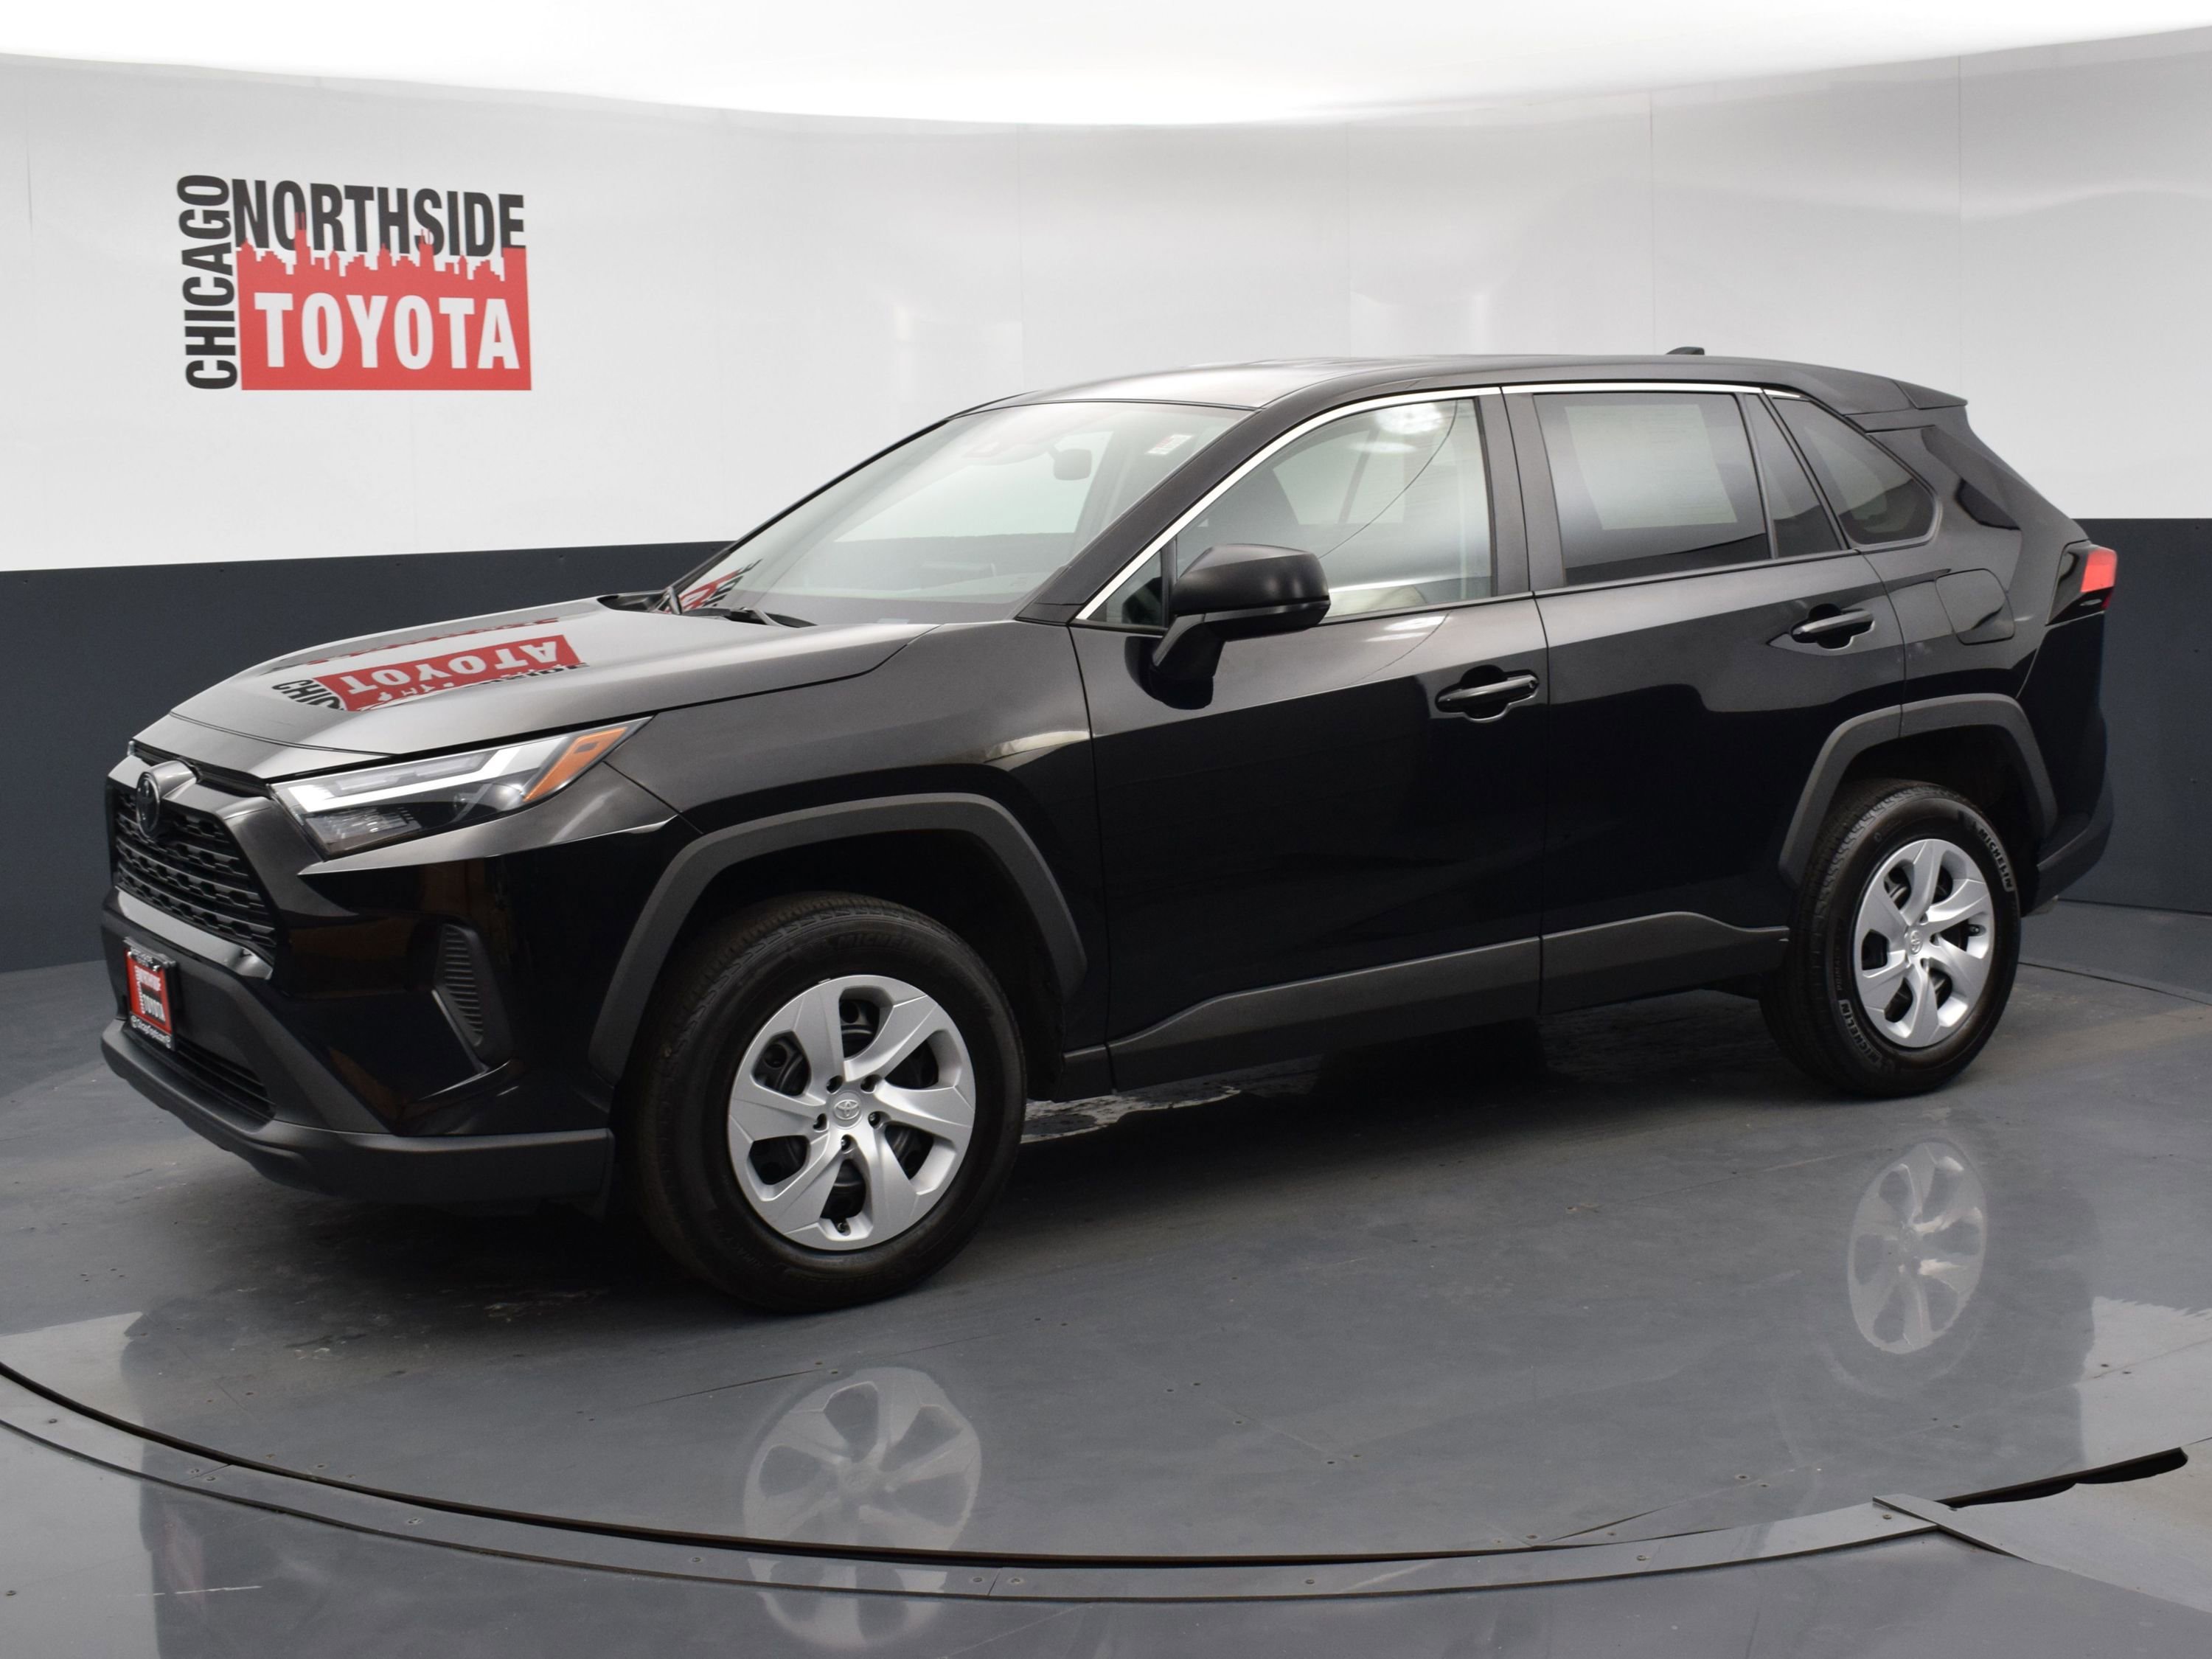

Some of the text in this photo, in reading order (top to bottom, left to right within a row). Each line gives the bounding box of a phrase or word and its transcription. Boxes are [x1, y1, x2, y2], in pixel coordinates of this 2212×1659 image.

[232, 178, 526, 257] NORTHSIDE
[177, 175, 237, 389] CHICAGO
[254, 292, 520, 369] TOYOTA
[1978, 828, 2013, 888] MICHELIN
